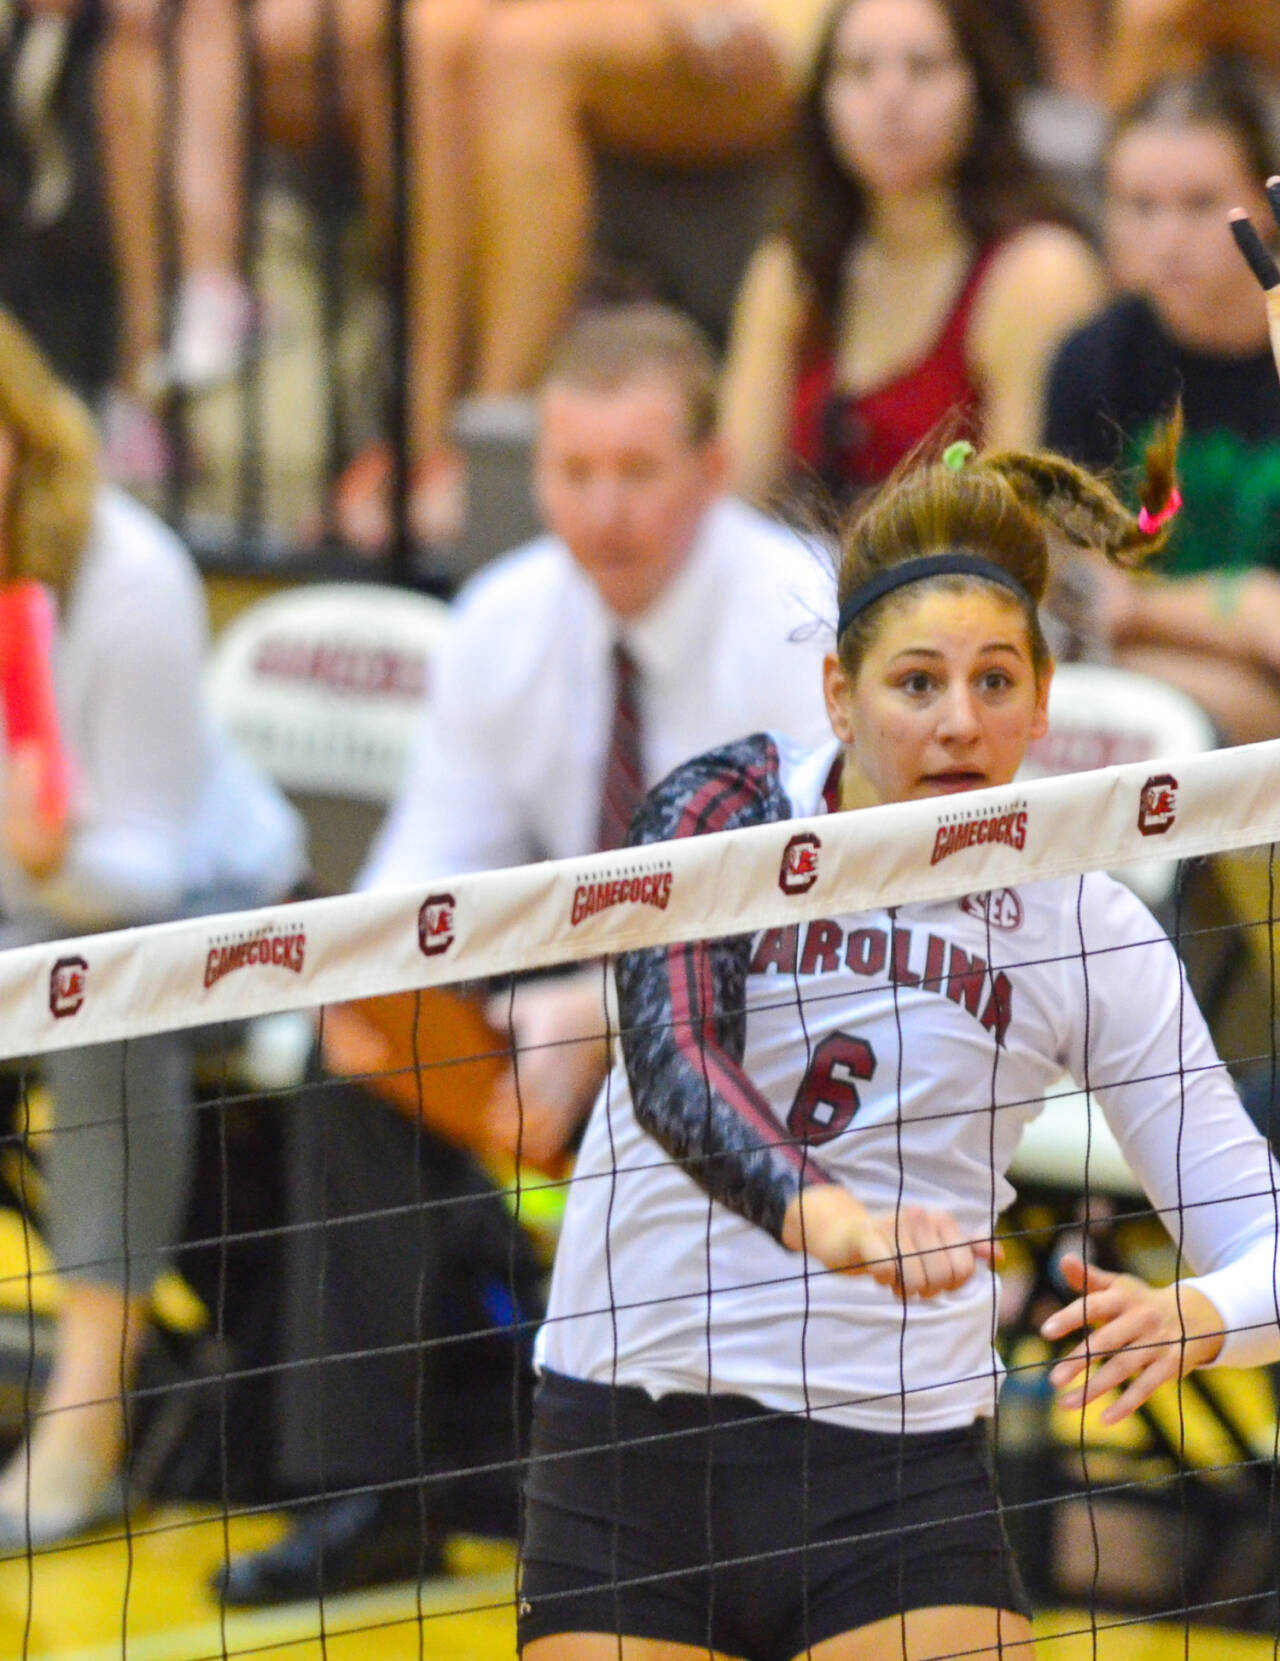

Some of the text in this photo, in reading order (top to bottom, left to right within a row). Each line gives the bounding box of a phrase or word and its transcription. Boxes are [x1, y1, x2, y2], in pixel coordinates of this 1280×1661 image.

[930, 812, 1027, 867] GAMECOCKS
[570, 872, 672, 926] GAMECOCKS
[204, 934, 306, 989] GAMECOCKS
[750, 918, 1013, 1049] AROLINA
[786, 1031, 877, 1146] 6
